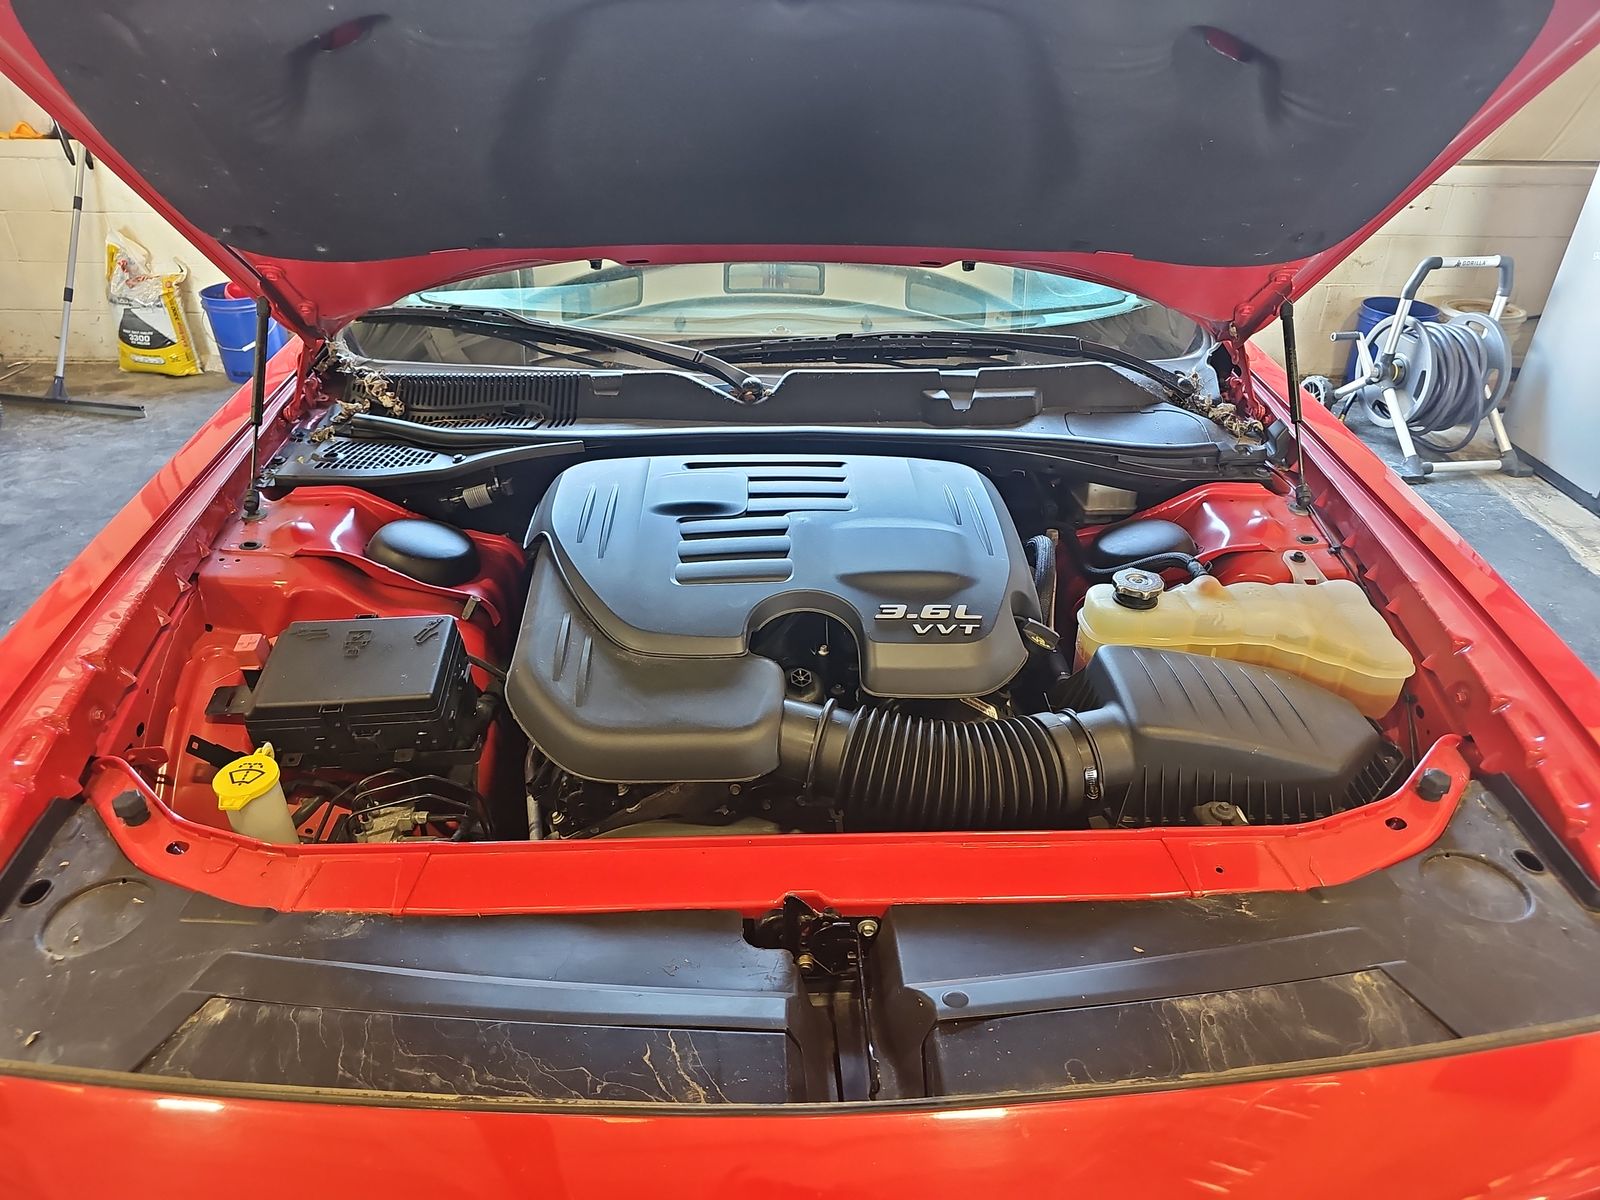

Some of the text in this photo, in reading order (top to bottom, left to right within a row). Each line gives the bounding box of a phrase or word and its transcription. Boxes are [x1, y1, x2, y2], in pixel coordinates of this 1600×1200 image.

[128, 334, 150, 342] 3300
[874, 604, 983, 620] 3.6L
[912, 623, 981, 635] VVT
